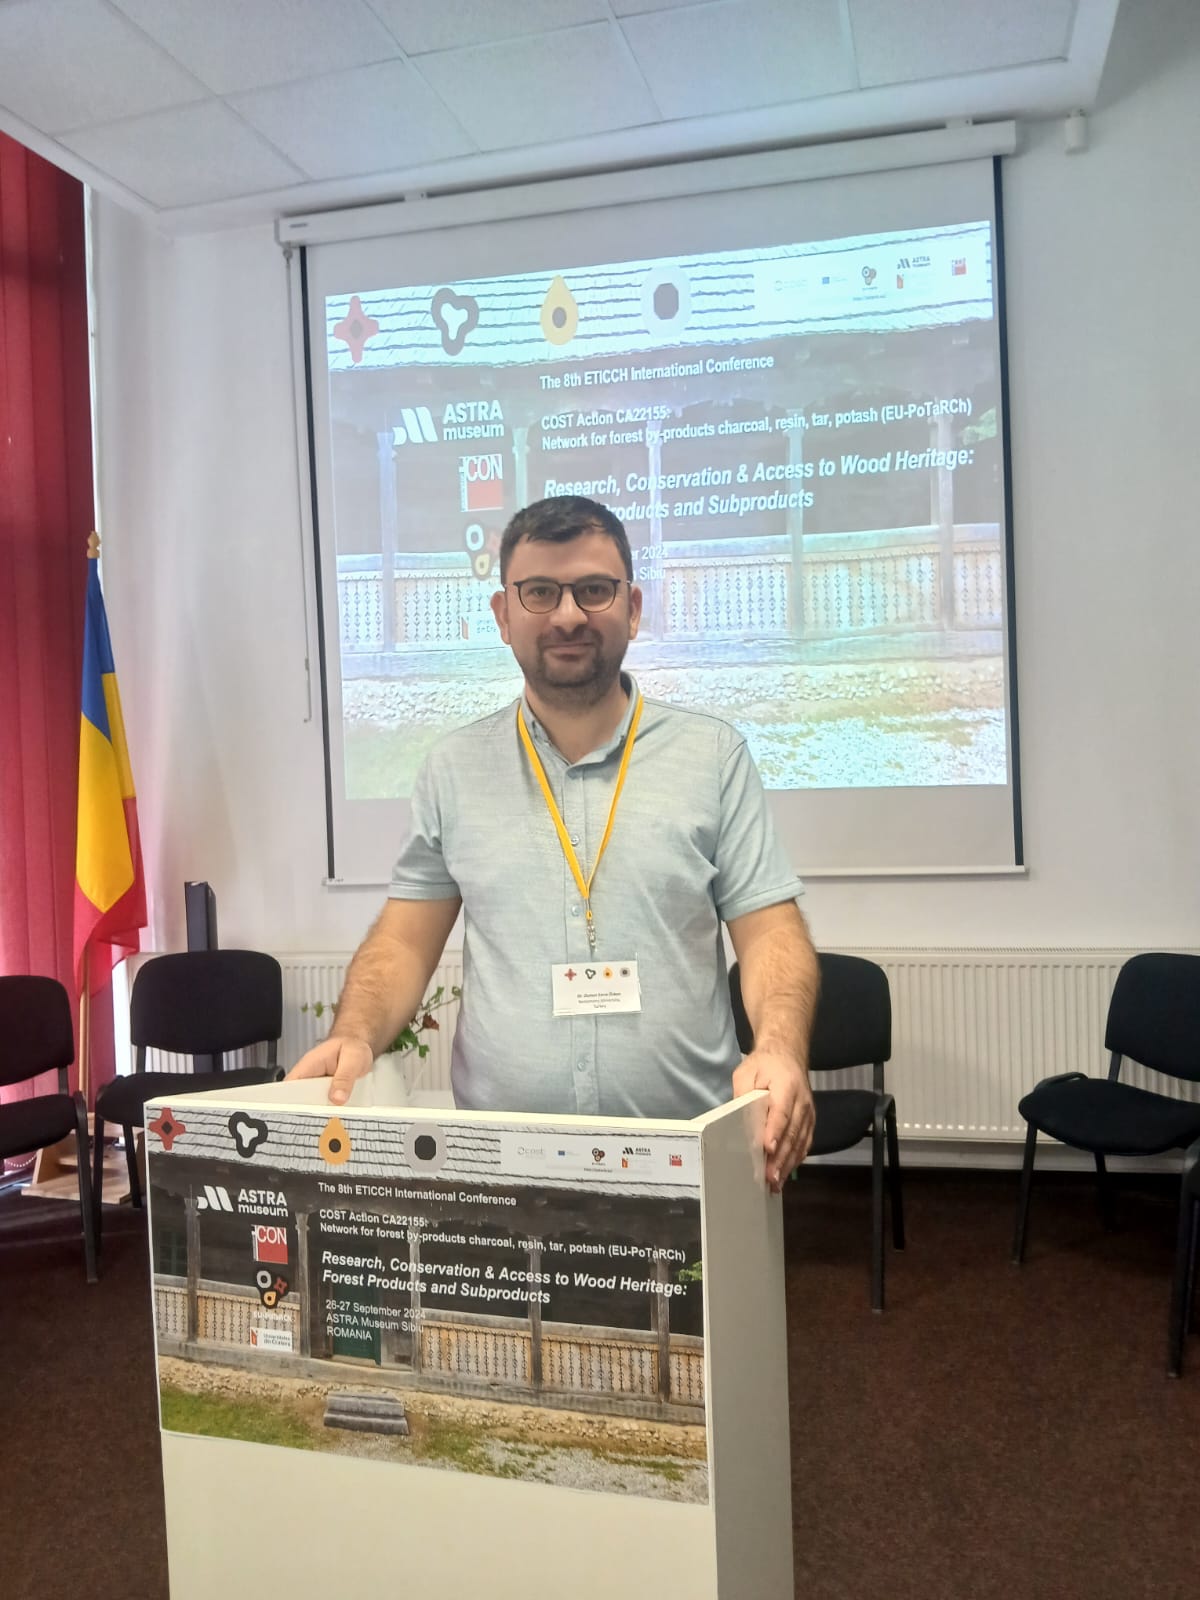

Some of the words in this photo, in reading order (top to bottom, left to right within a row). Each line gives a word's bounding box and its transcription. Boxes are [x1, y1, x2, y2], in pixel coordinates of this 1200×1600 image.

[540, 375, 561, 389] The
[563, 371, 582, 387] 8th
[584, 367, 628, 385] ETICCH
[631, 360, 703, 380] International
[706, 356, 774, 373] Conference
[443, 400, 503, 424] ASTRA
[541, 412, 574, 430] COST
[577, 408, 614, 425] Action
[542, 432, 588, 450] Network
[591, 429, 608, 445] for
[610, 426, 643, 443] forest
[646, 420, 716, 441] by-products
[718, 416, 773, 434] charcoal,
[775, 414, 809, 429] resin,
[811, 410, 833, 427] tar,
[835, 408, 879, 427] potash
[881, 398, 973, 424] (EU-PoTaRCh)
[444, 423, 504, 441] museum
[544, 475, 621, 499] Research,
[626, 466, 732, 492] Conservation
[737, 464, 749, 483] &
[752, 457, 815, 482] Access
[818, 457, 836, 477] to
[840, 452, 891, 475] Wood
[894, 448, 975, 471] Heritage:
[605, 501, 669, 521] roducts
[673, 495, 705, 518] and
[708, 489, 814, 516] Subproducts
[237, 1188, 288, 1207] ASTRA
[318, 1182, 336, 1194] The
[338, 1183, 353, 1195] 8th
[355, 1185, 392, 1198] ETICCH
[395, 1188, 456, 1202] International
[458, 1192, 517, 1207] Conference
[237, 1204, 289, 1218] museum
[319, 1209, 347, 1221] COST
[349, 1212, 380, 1224] Action
[320, 1222, 359, 1236] Network
[360, 1226, 374, 1237] for
[376, 1228, 405, 1240] forest
[407, 1230, 467, 1246] by-products
[468, 1236, 515, 1250] charcoal,
[517, 1240, 547, 1252] resin,
[549, 1240, 567, 1254] tar,
[569, 1242, 606, 1256] potash
[608, 1244, 687, 1264] (EU-PoTaRCh)
[321, 1250, 386, 1272] Research,
[390, 1257, 481, 1279] Conservation
[485, 1265, 496, 1280] &
[498, 1266, 551, 1285] Access
[555, 1271, 570, 1286] to
[573, 1273, 617, 1290] Wood
[620, 1276, 688, 1299] Heritage:
[322, 1269, 365, 1287] Forest
[367, 1273, 428, 1293] Products
[430, 1282, 457, 1296] and
[460, 1282, 552, 1304] Subproducts
[325, 1299, 351, 1311] 26-27
[353, 1302, 402, 1317] September
[403, 1308, 426, 1320] 2024
[326, 1313, 359, 1326] ASTRA
[361, 1317, 400, 1331] Museum
[326, 1325, 373, 1342] ROMANIA
